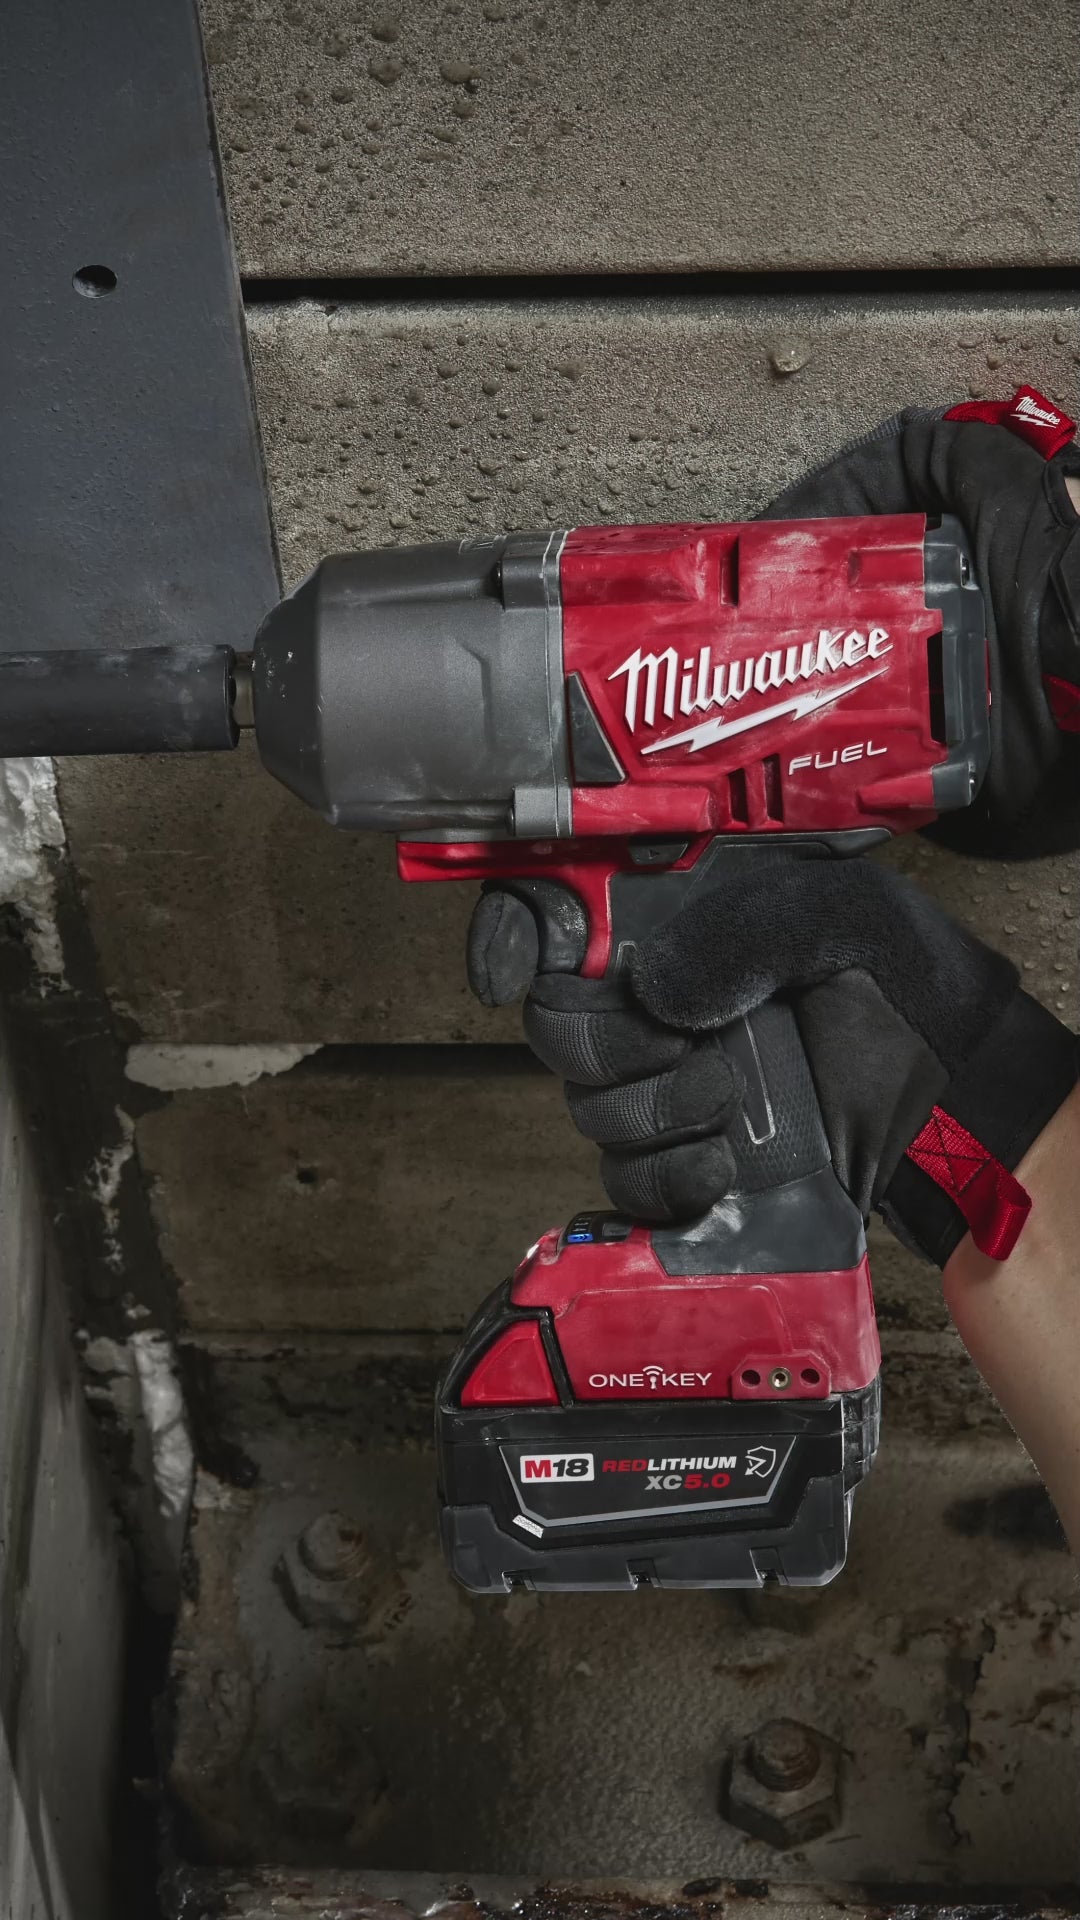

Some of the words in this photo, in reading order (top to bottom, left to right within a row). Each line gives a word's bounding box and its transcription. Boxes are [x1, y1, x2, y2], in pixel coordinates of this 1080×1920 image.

[1016, 396, 1061, 425] Milwaukee
[607, 627, 895, 734] Milwaukee
[788, 741, 888, 776] FUEL
[588, 1373, 645, 1388] ONE
[661, 1372, 713, 1387] KEY
[524, 1458, 590, 1479] M18
[602, 1456, 737, 1473] REDLITHIUM
